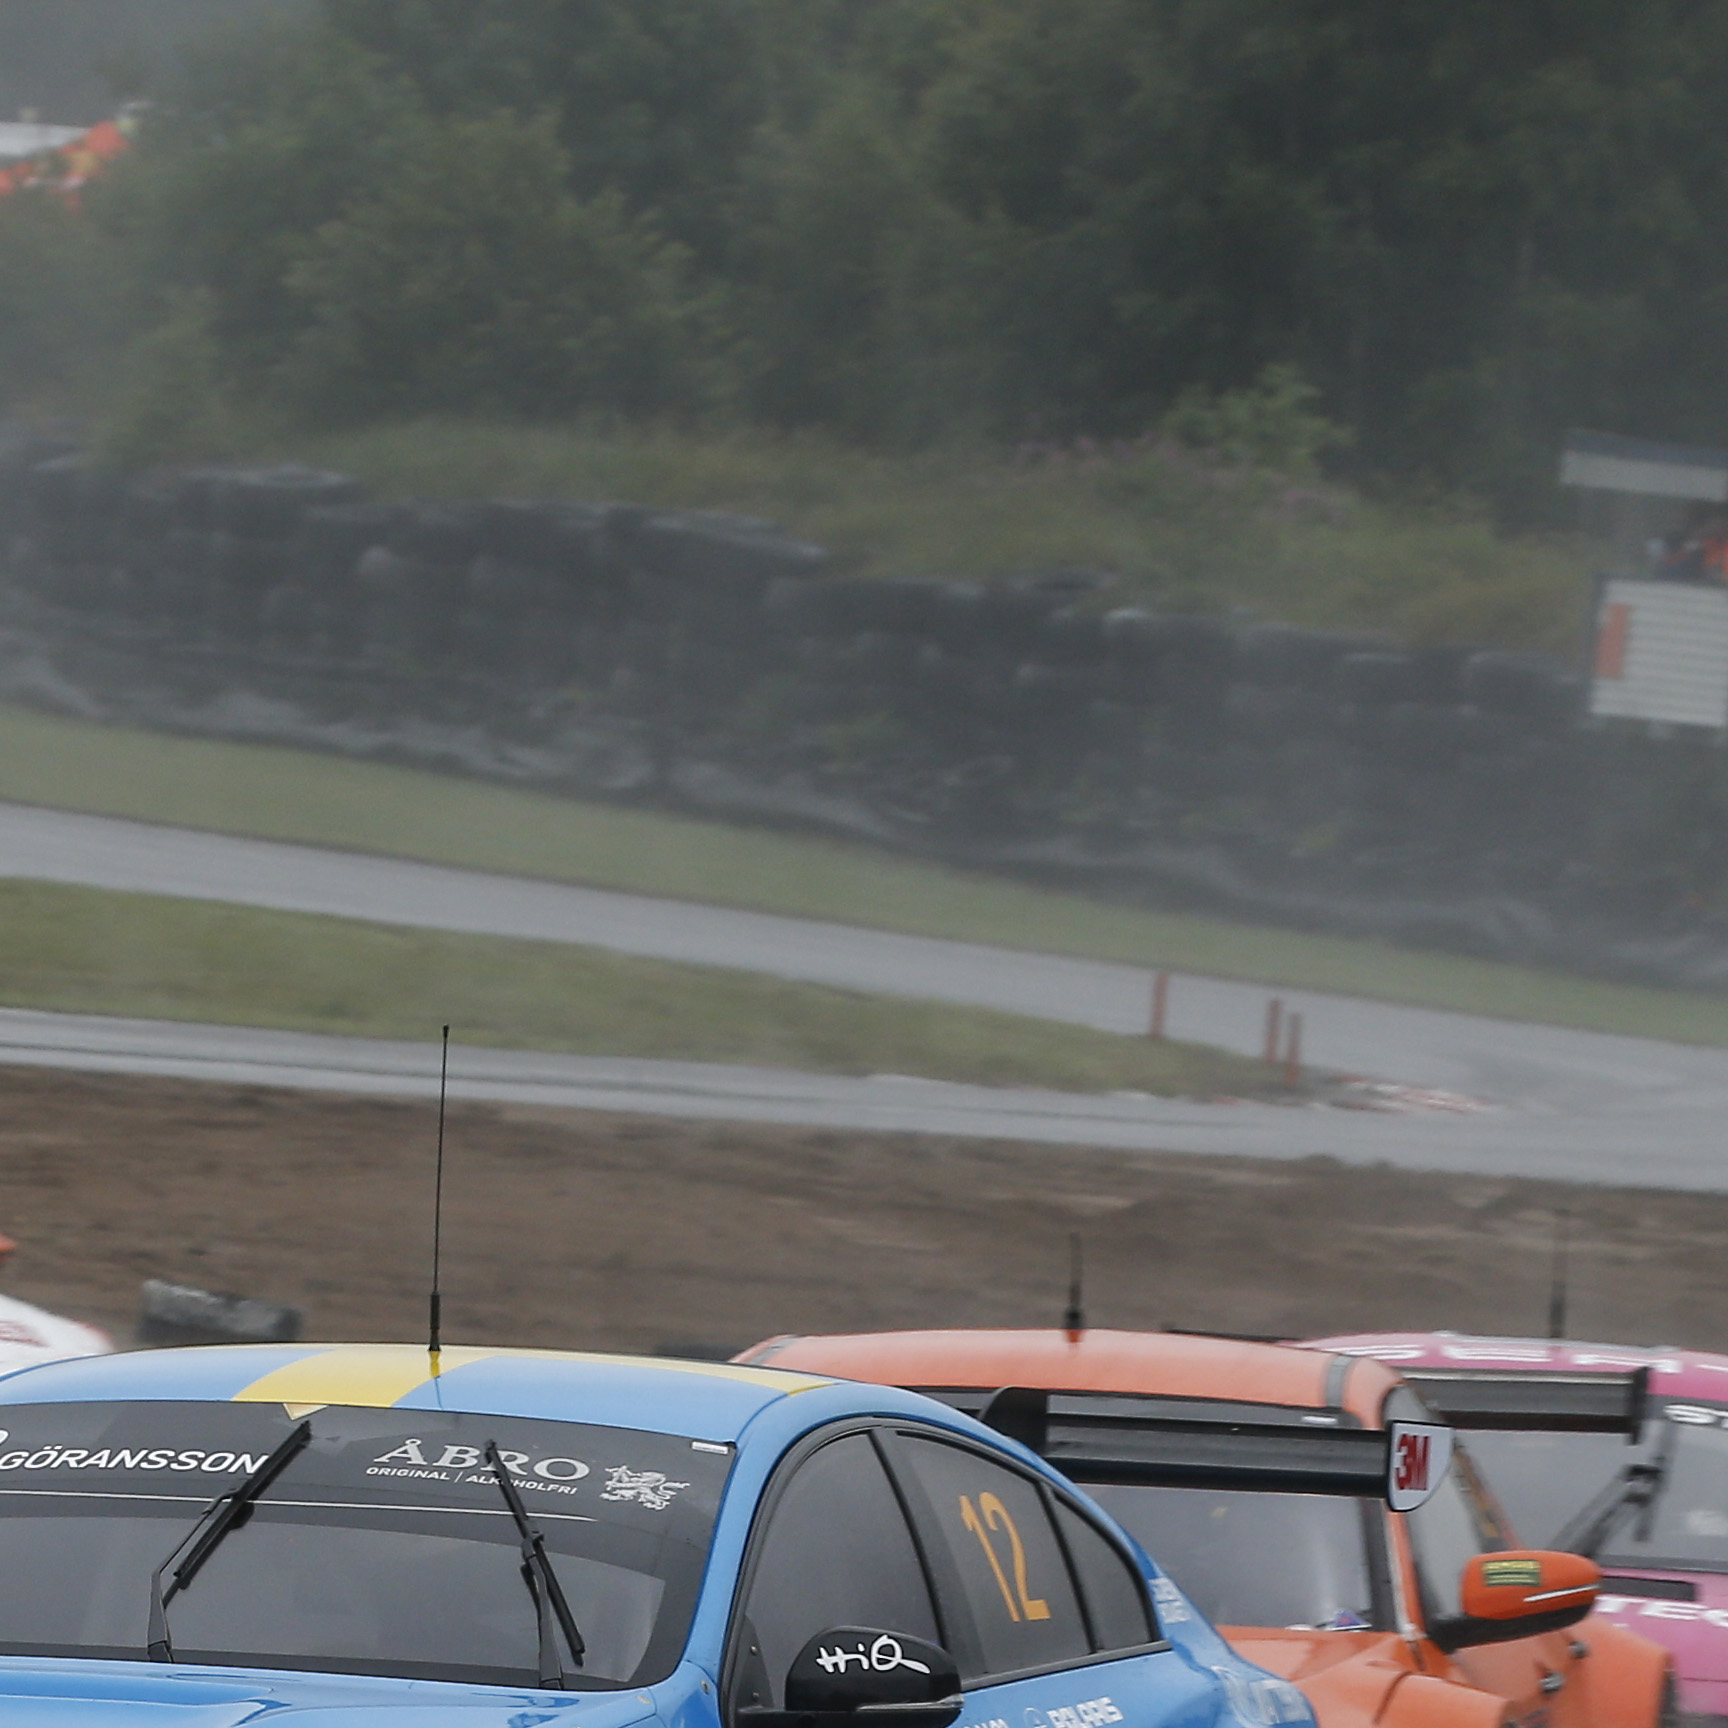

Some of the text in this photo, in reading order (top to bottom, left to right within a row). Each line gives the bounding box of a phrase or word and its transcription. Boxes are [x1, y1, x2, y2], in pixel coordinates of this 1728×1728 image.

[373, 1438, 590, 1481] ÅBRO
[366, 1466, 578, 1496] ORIGINAL ALKHOLFRI
[960, 1491, 1051, 1622] 12
[816, 1634, 931, 1675] HiQ
